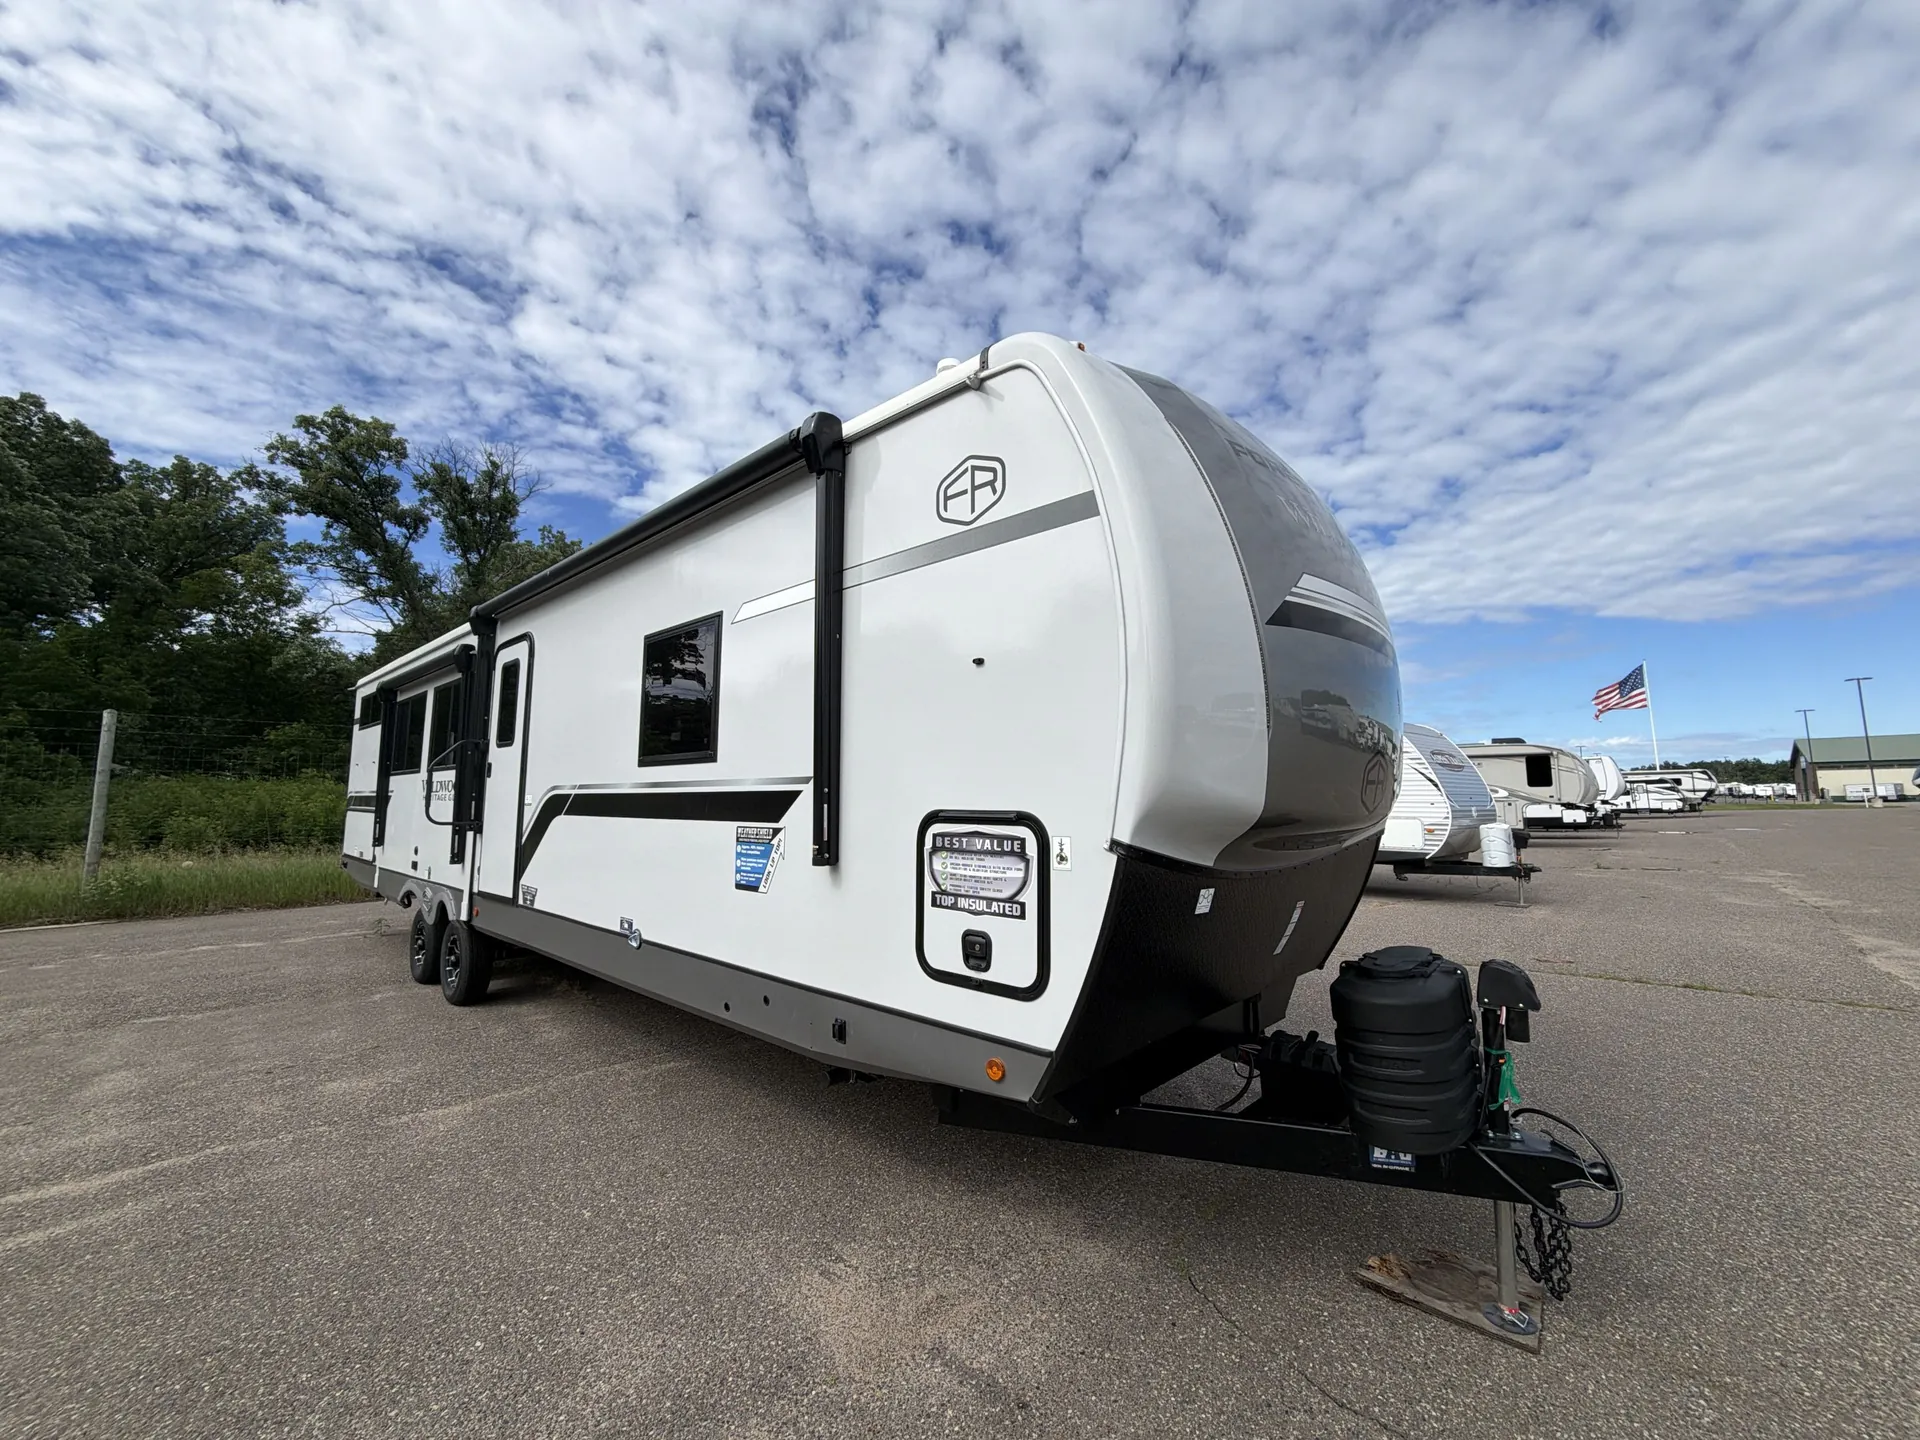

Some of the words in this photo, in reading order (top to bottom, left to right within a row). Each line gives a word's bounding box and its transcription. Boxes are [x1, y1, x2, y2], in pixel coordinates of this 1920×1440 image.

[935, 836, 968, 849] BEST
[975, 839, 1022, 853] VALUE
[935, 894, 955, 908] TOP
[957, 897, 1021, 916] INSULATED
